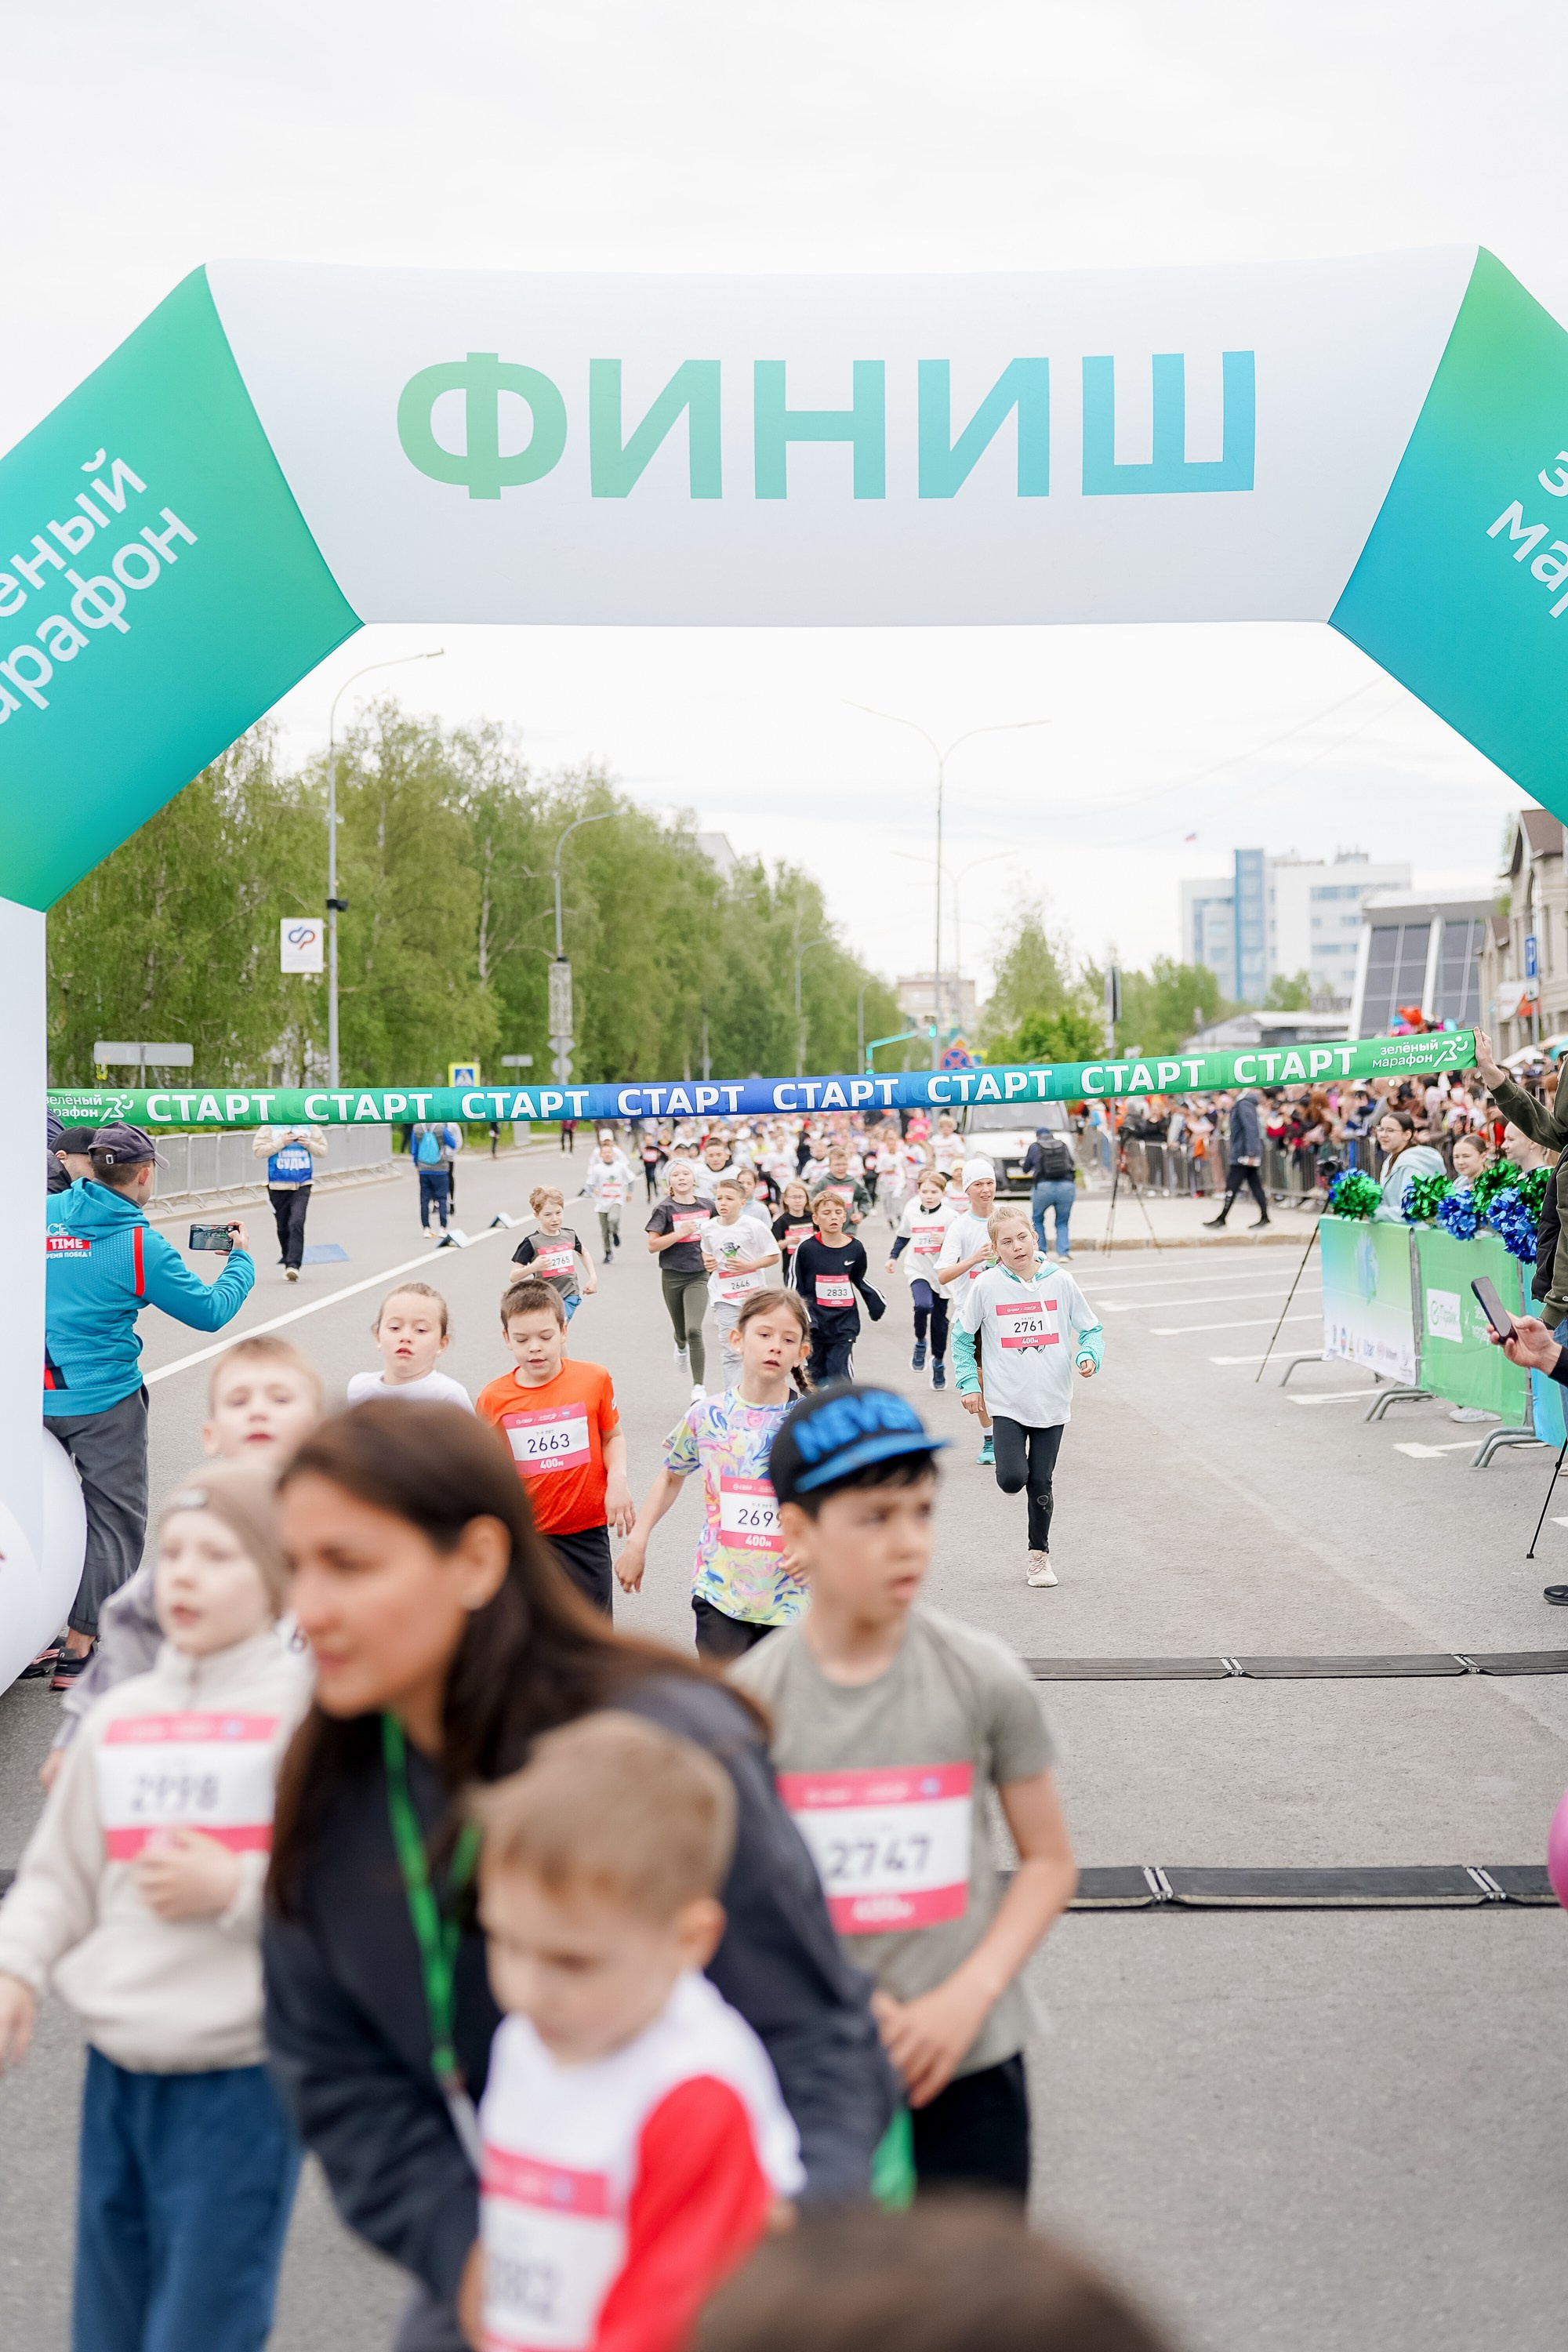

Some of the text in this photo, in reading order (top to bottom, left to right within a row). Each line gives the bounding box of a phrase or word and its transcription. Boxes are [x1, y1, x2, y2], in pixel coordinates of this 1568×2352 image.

[397, 350, 1254, 500] ФИНИШ
[1486, 499, 1568, 619] ма
[1380, 1038, 1439, 1056] зелёный
[1373, 1054, 1433, 1069] марафон
[146, 1047, 1358, 1122] СТАРТ СТАРТ СТАРТ СТАРТ СТАРТ СТАРТ СТАРТ СТАРТ
[46, 1223, 69, 1236] CE
[49, 1238, 84, 1250] TIME
[552, 1257, 570, 1266] 2765
[731, 1280, 750, 1290] 2646
[1014, 1320, 1044, 1333] 2761
[528, 1433, 570, 1454] 2663
[539, 1457, 564, 1469] 400м
[745, 1534, 772, 1548] 400м
[831, 1835, 931, 1878] 2747
